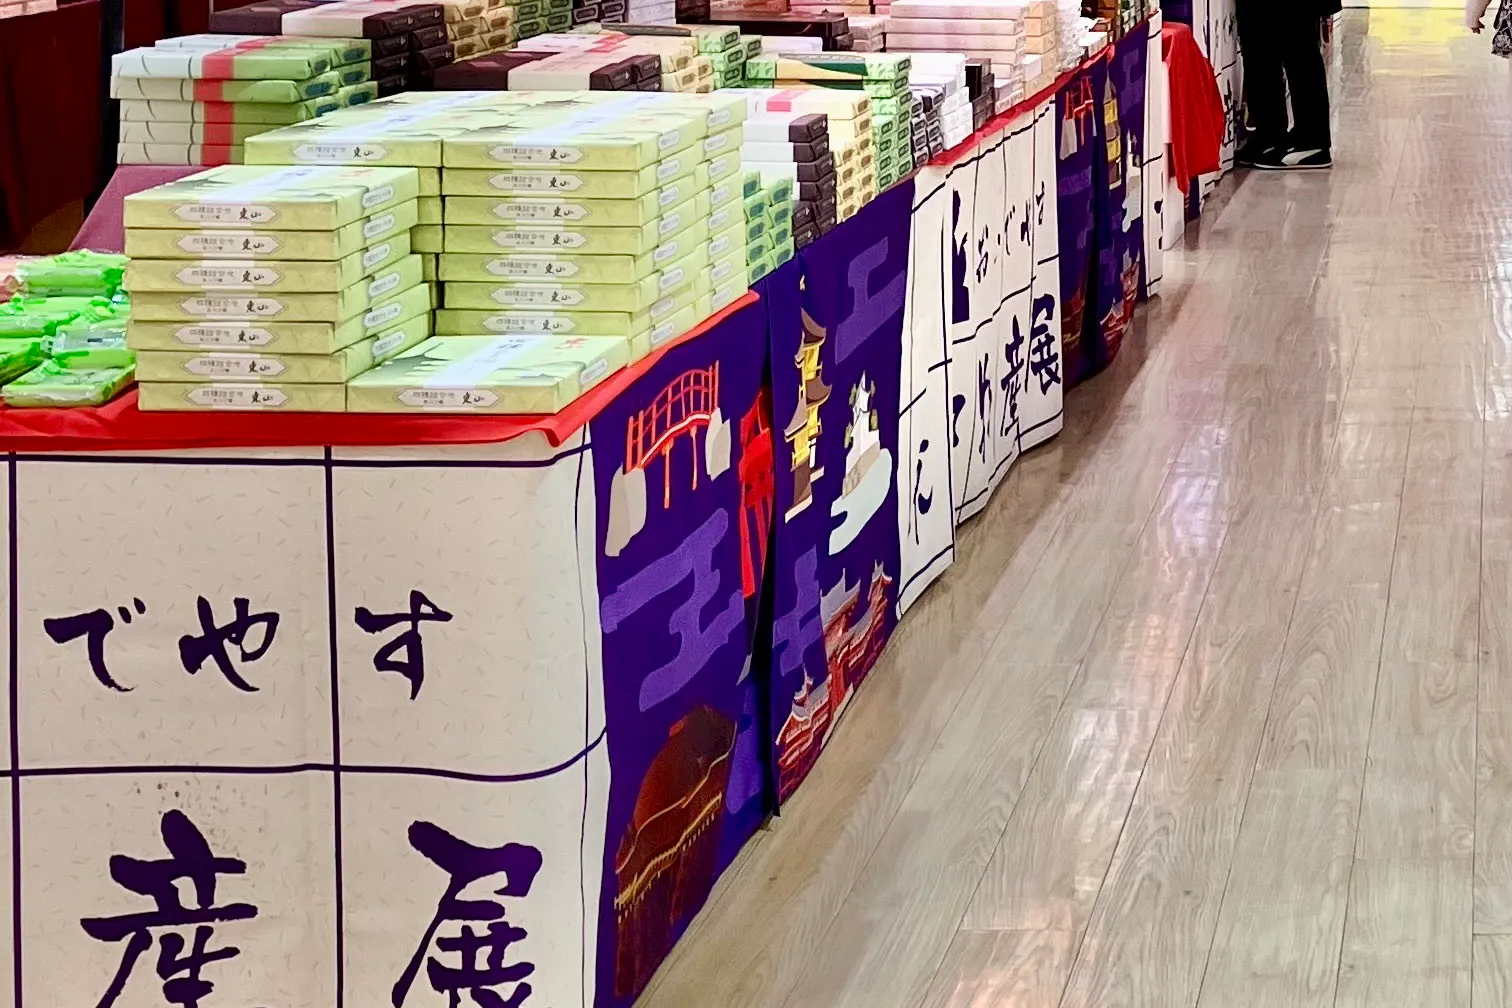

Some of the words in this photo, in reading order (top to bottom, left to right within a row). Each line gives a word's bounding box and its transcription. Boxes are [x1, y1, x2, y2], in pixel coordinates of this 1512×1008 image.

[43, 590, 454, 701] でやす
[80, 809, 543, 1008] 産展
